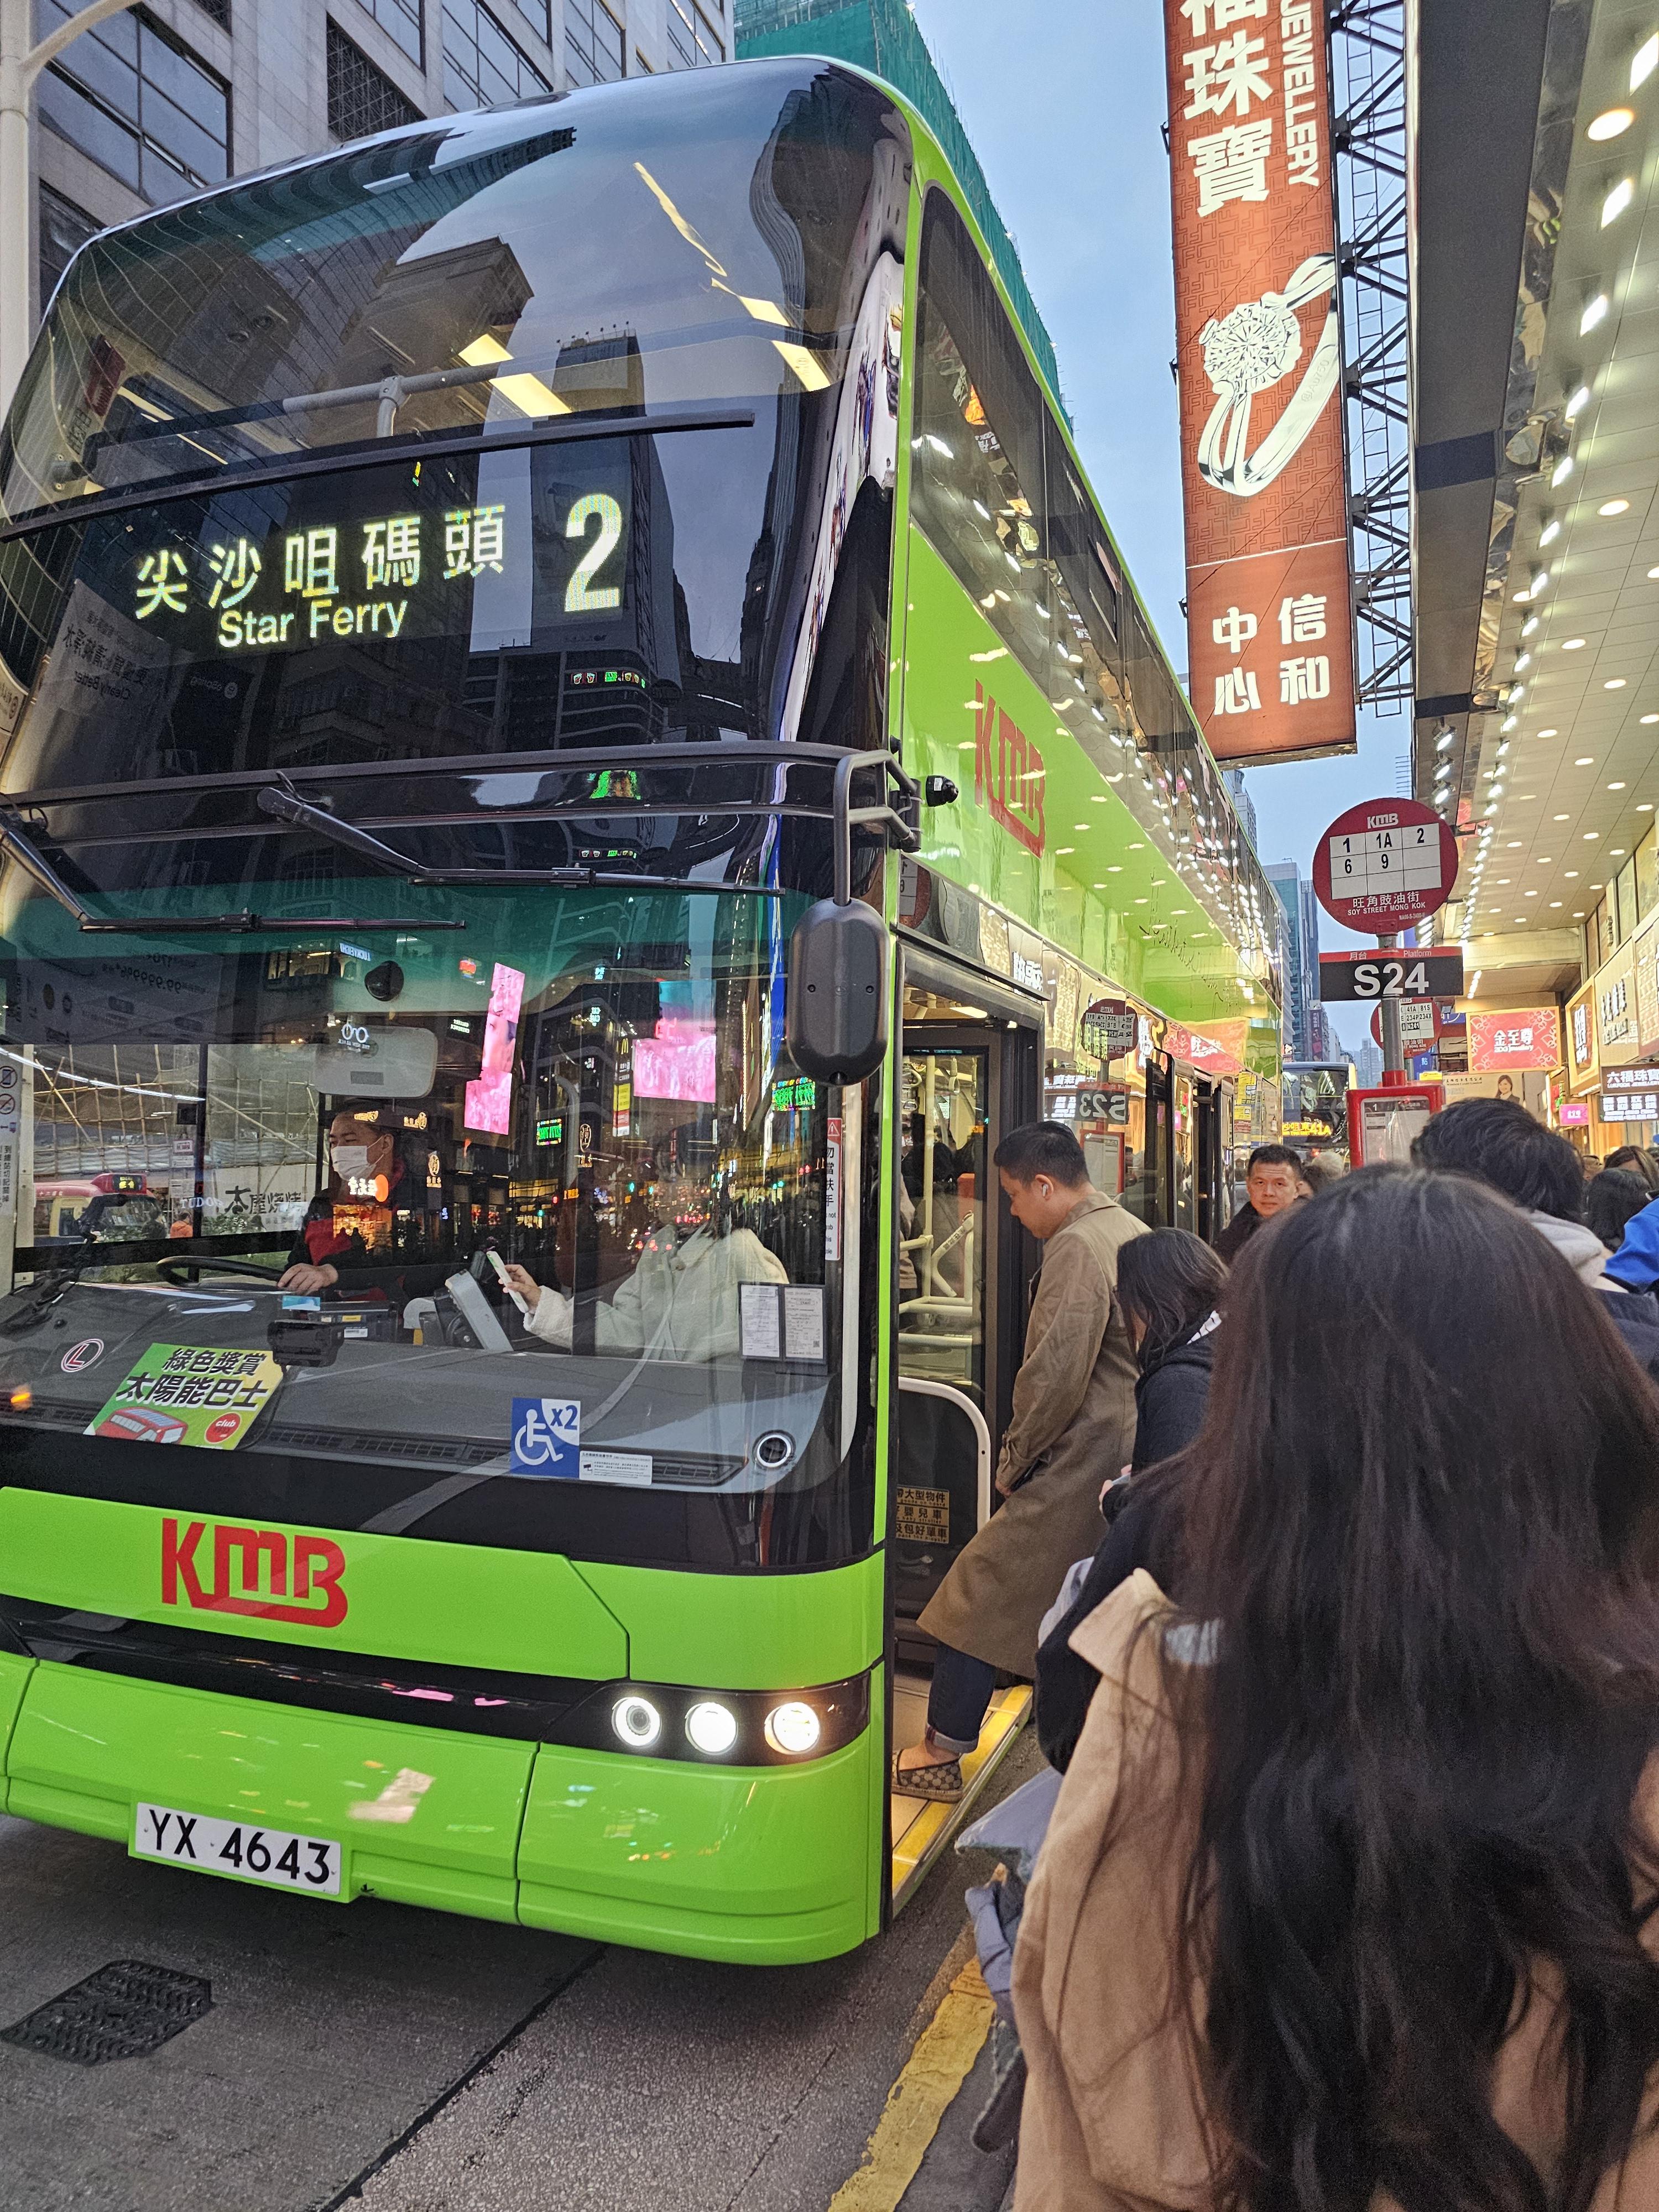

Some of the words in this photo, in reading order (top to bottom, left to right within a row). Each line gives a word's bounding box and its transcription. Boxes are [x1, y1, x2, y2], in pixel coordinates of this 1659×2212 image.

[1280, 0, 1319, 187] JEWELLERY
[135, 504, 506, 620] 尖沙咀碼頭
[565, 493, 623, 612] 2
[218, 604, 294, 649] Star
[309, 597, 408, 639] Ferry
[974, 678, 1046, 859] KMB
[1367, 813, 1399, 829] KMB
[1343, 837, 1350, 853] 1
[1376, 832, 1392, 849] 1A
[1417, 827, 1425, 844] 2
[1344, 858, 1352, 874] 6
[1381, 853, 1389, 869] 9
[1353, 891, 1420, 909] 旺角豉油街
[1349, 952, 1367, 961] 月台
[1354, 962, 1430, 997] S24
[1494, 1027, 1534, 1047] 金至尊
[161, 1348, 267, 1376] 綠色獎賞
[116, 1371, 270, 1411] 太陽能巴士
[215, 1419, 237, 1428] club
[161, 1517, 348, 1629] KMB
[149, 1809, 197, 1859] YX
[218, 1827, 331, 1885] 4643
